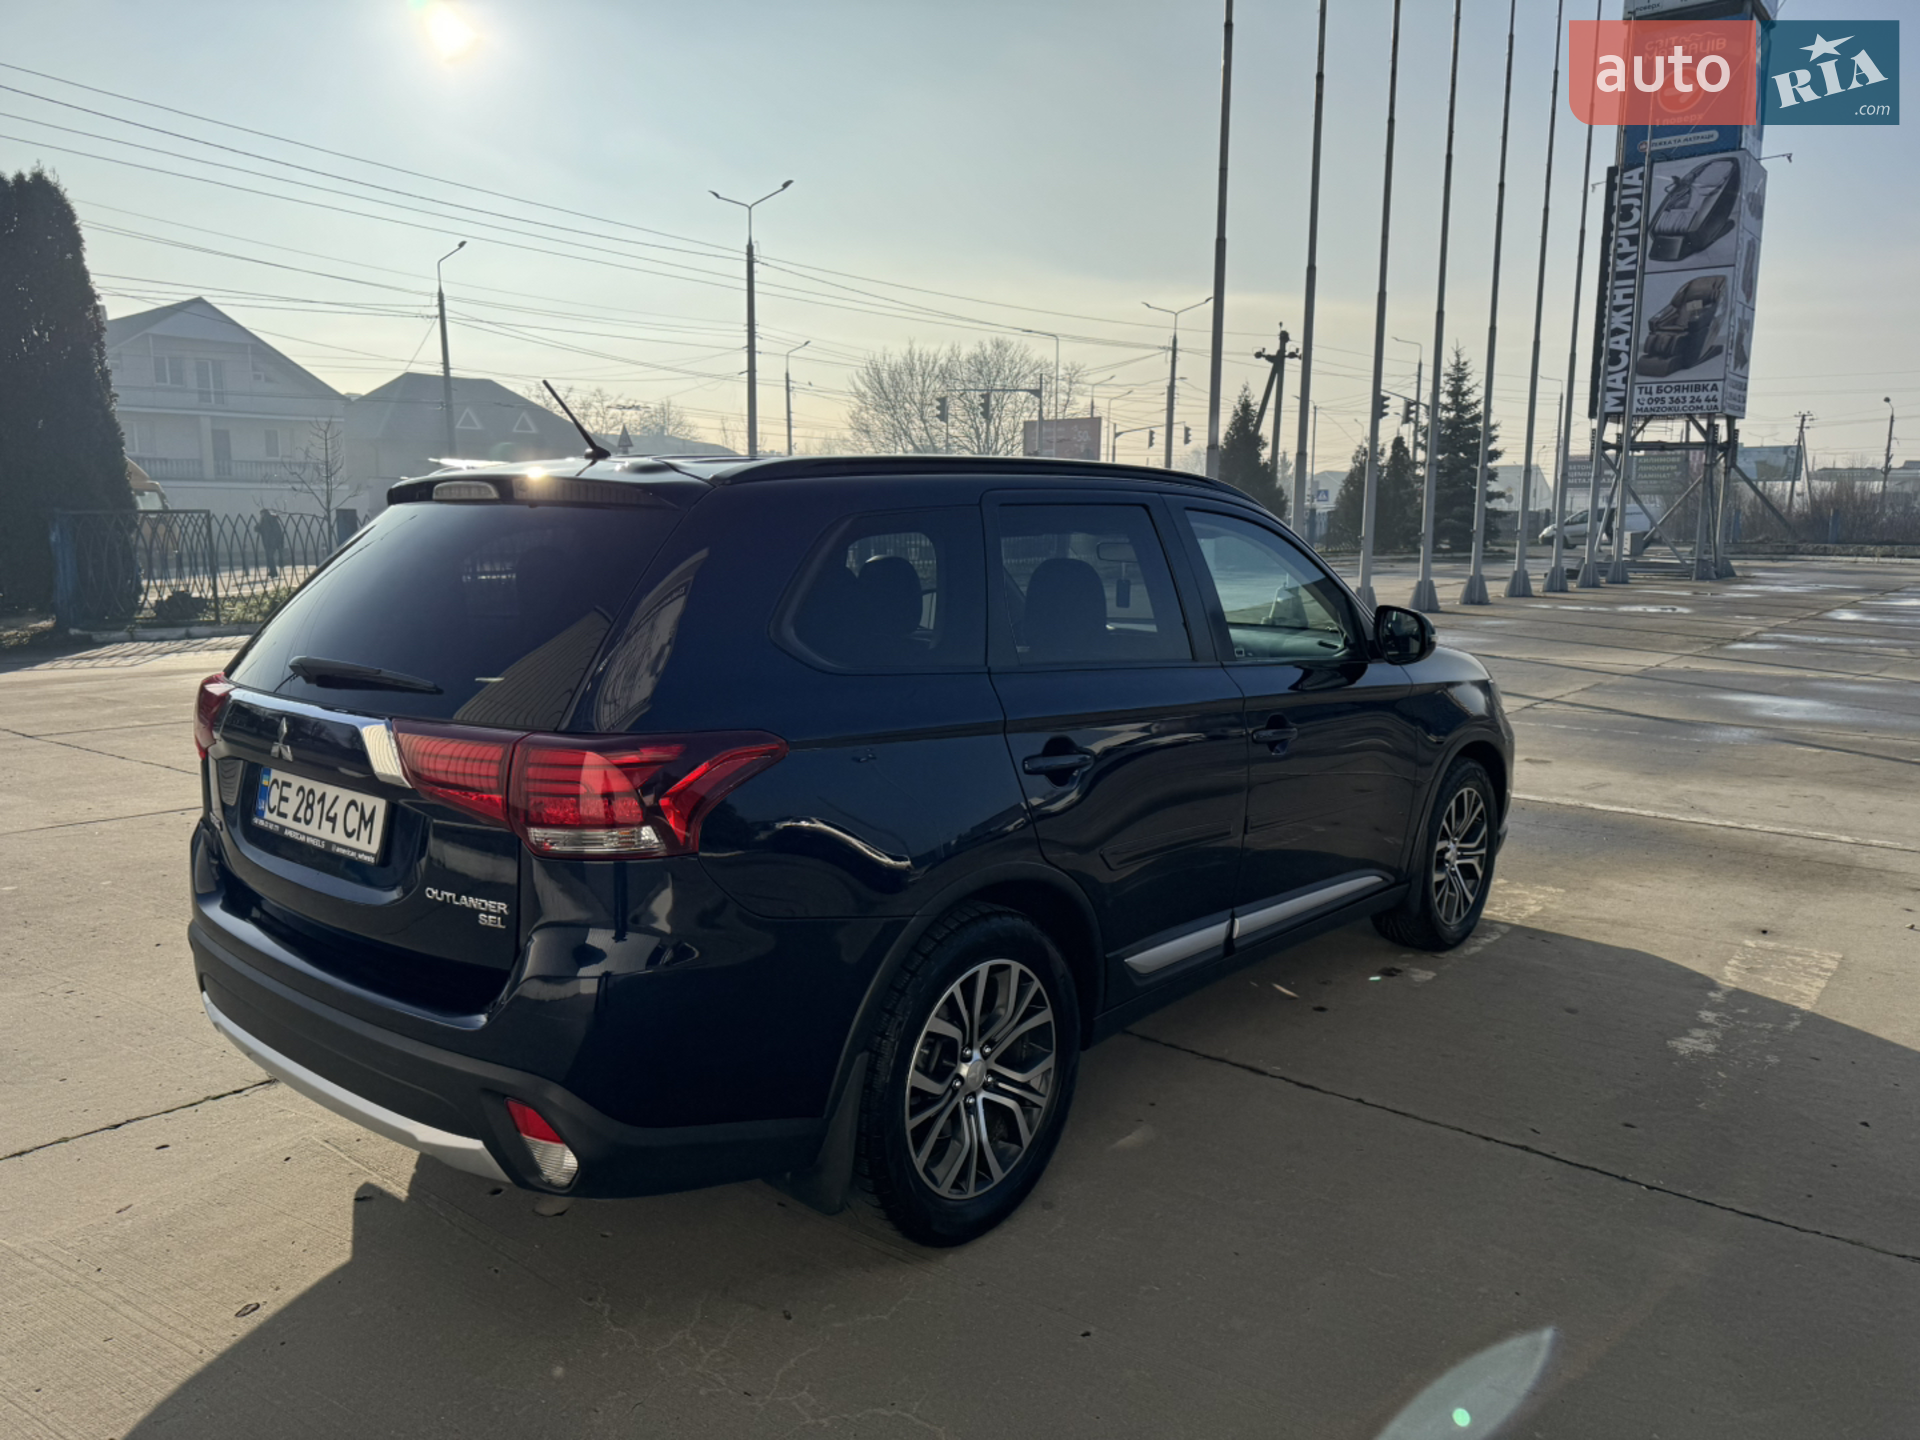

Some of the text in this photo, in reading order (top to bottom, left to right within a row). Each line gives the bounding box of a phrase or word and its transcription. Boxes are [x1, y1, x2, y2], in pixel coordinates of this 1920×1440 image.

[1598, 166, 1645, 413] МАСАЖНІ КРІСЛА
[1637, 383, 1719, 396] ТЦ БОЯНІВКА
[1647, 394, 1718, 406] 095 363 24 44
[1635, 404, 1719, 413] MANZOKU.COM.UA
[267, 778, 376, 845] CE 2814 CM
[425, 887, 509, 915] OUTLANDER
[478, 913, 506, 929] SEL
